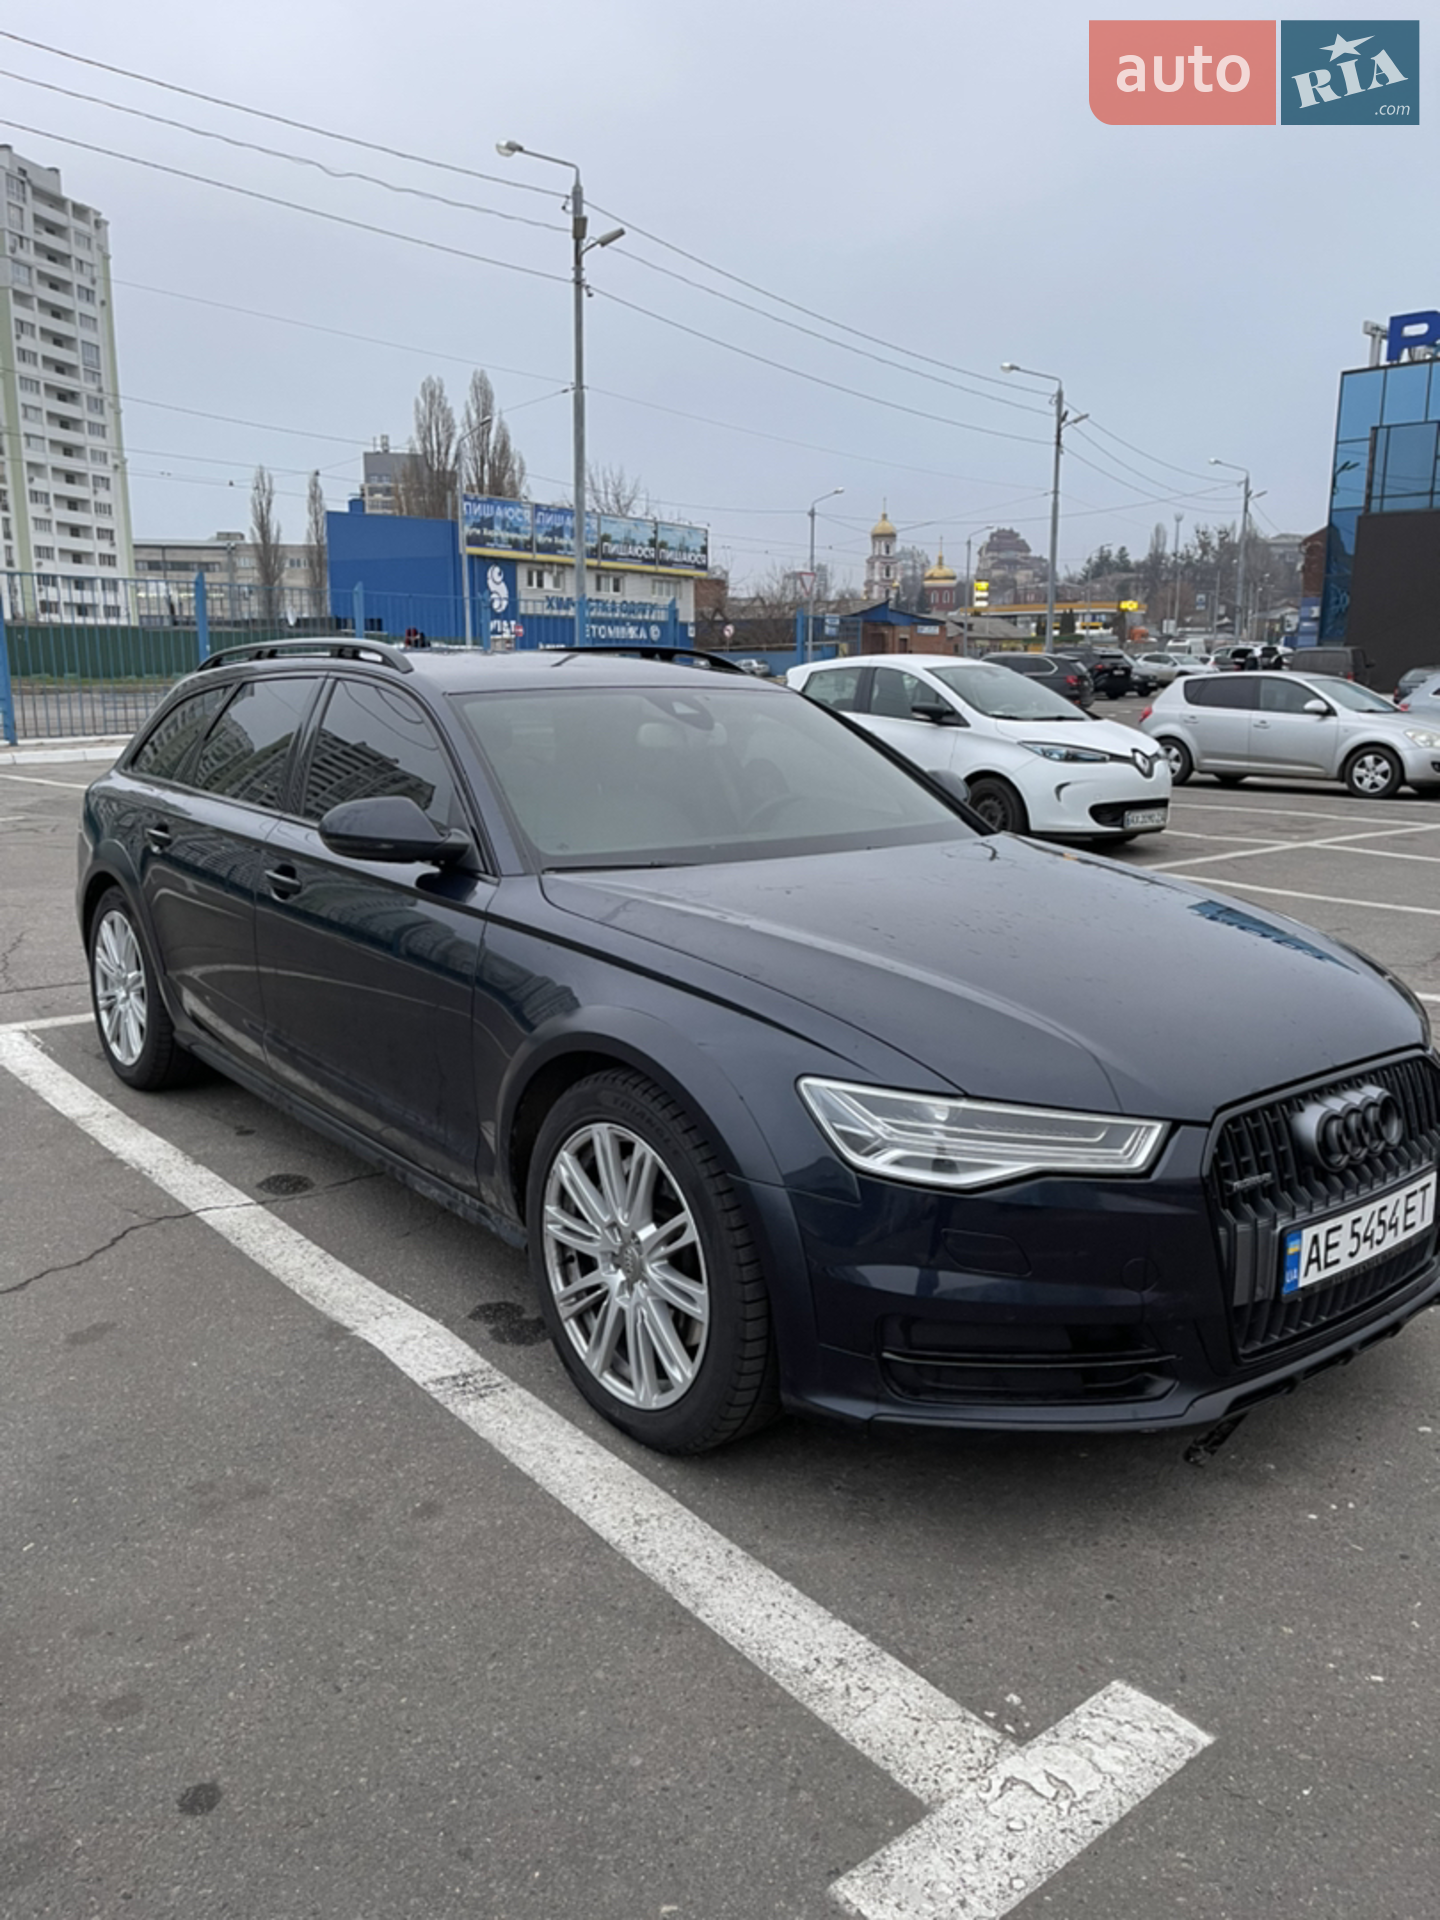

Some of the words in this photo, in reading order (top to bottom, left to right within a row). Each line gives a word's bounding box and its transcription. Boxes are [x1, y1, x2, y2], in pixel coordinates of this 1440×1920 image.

[463, 502, 531, 522] ПИШАЮСЯ
[603, 541, 656, 559] ПИШАЮСЯ
[659, 548, 707, 565] ПИШАЮСЯ
[1303, 1224, 1343, 1278] AE
[1348, 1198, 1400, 1258] 5454
[1403, 1182, 1431, 1233] ET
